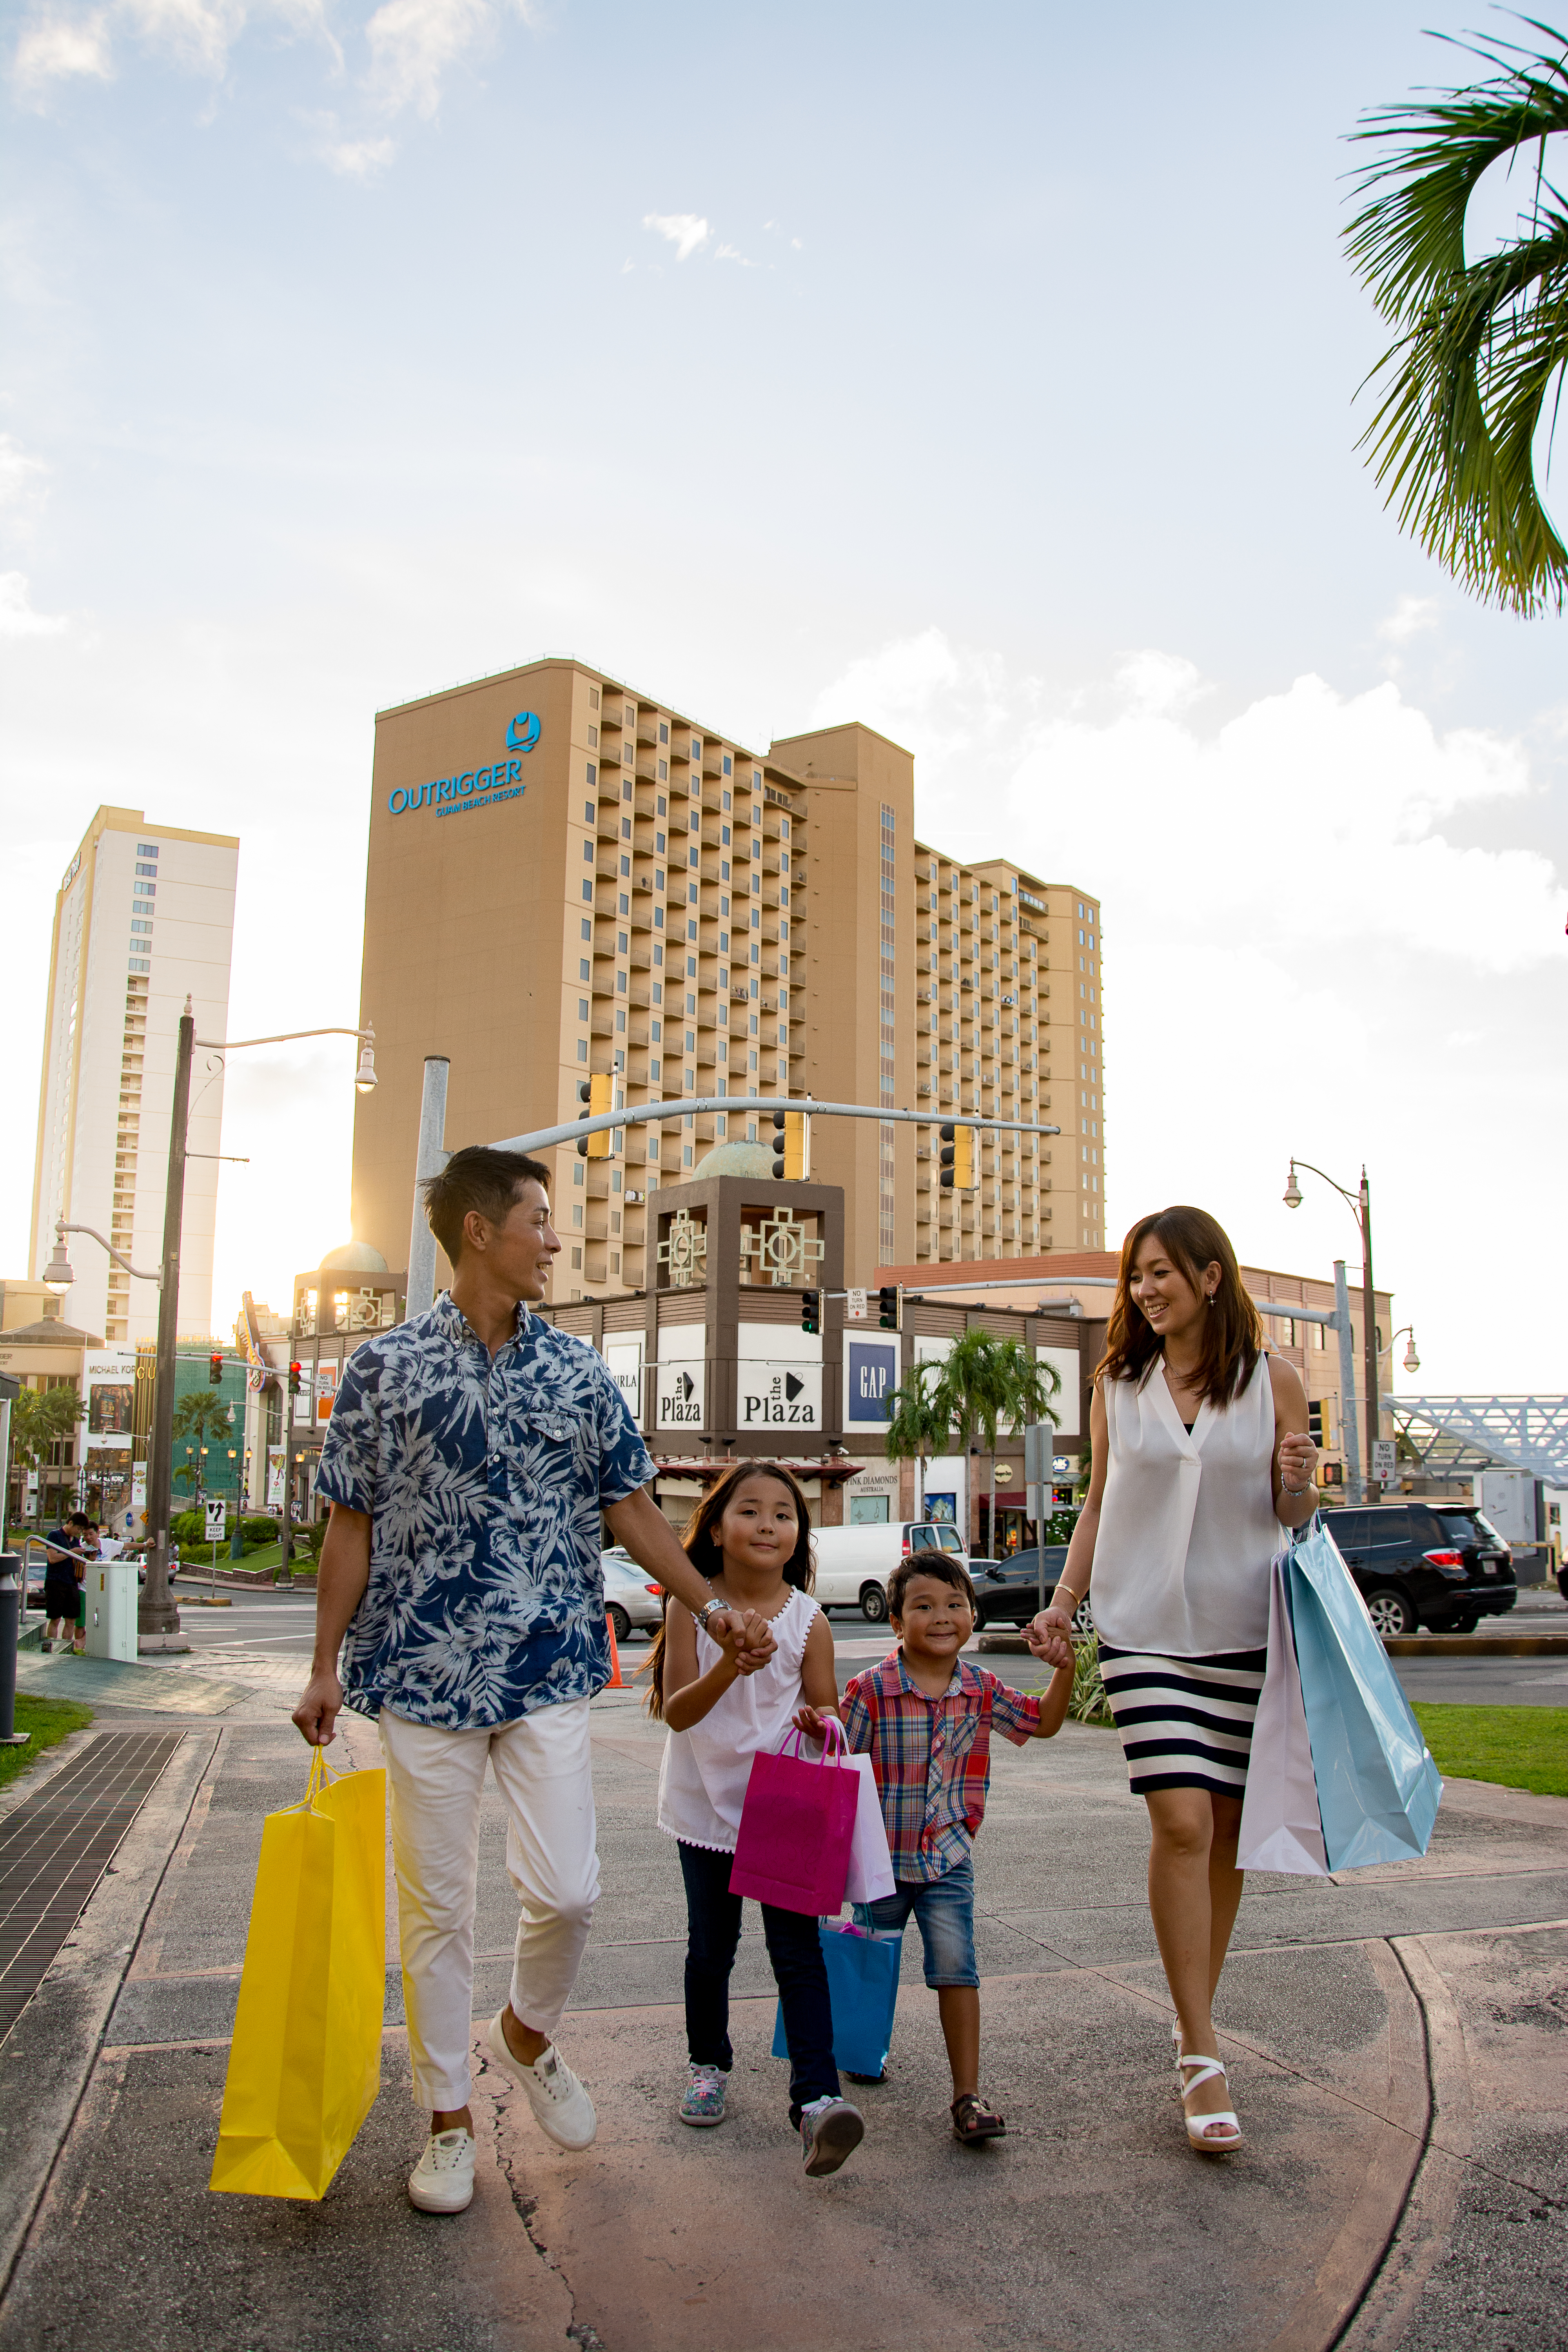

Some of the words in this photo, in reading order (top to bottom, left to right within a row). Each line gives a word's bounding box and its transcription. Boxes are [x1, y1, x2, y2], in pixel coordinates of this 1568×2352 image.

[388, 759, 521, 814] OUTRIGGER
[436, 802, 461, 817] GUAM
[462, 795, 491, 811] BEACH
[492, 785, 526, 802] RESORT
[89, 1365, 119, 1374] MICHAEL
[122, 1365, 135, 1374] KOR
[614, 1375, 637, 1387] URLA
[770, 1377, 781, 1401] the
[860, 1366, 886, 1398] GAP
[661, 1397, 701, 1422] Plaza
[744, 1396, 815, 1423] Plaza
[1053, 1458, 1067, 1466] ABC
[846, 1477, 862, 1485] PINK
[863, 1476, 898, 1485] DIAMONDS
